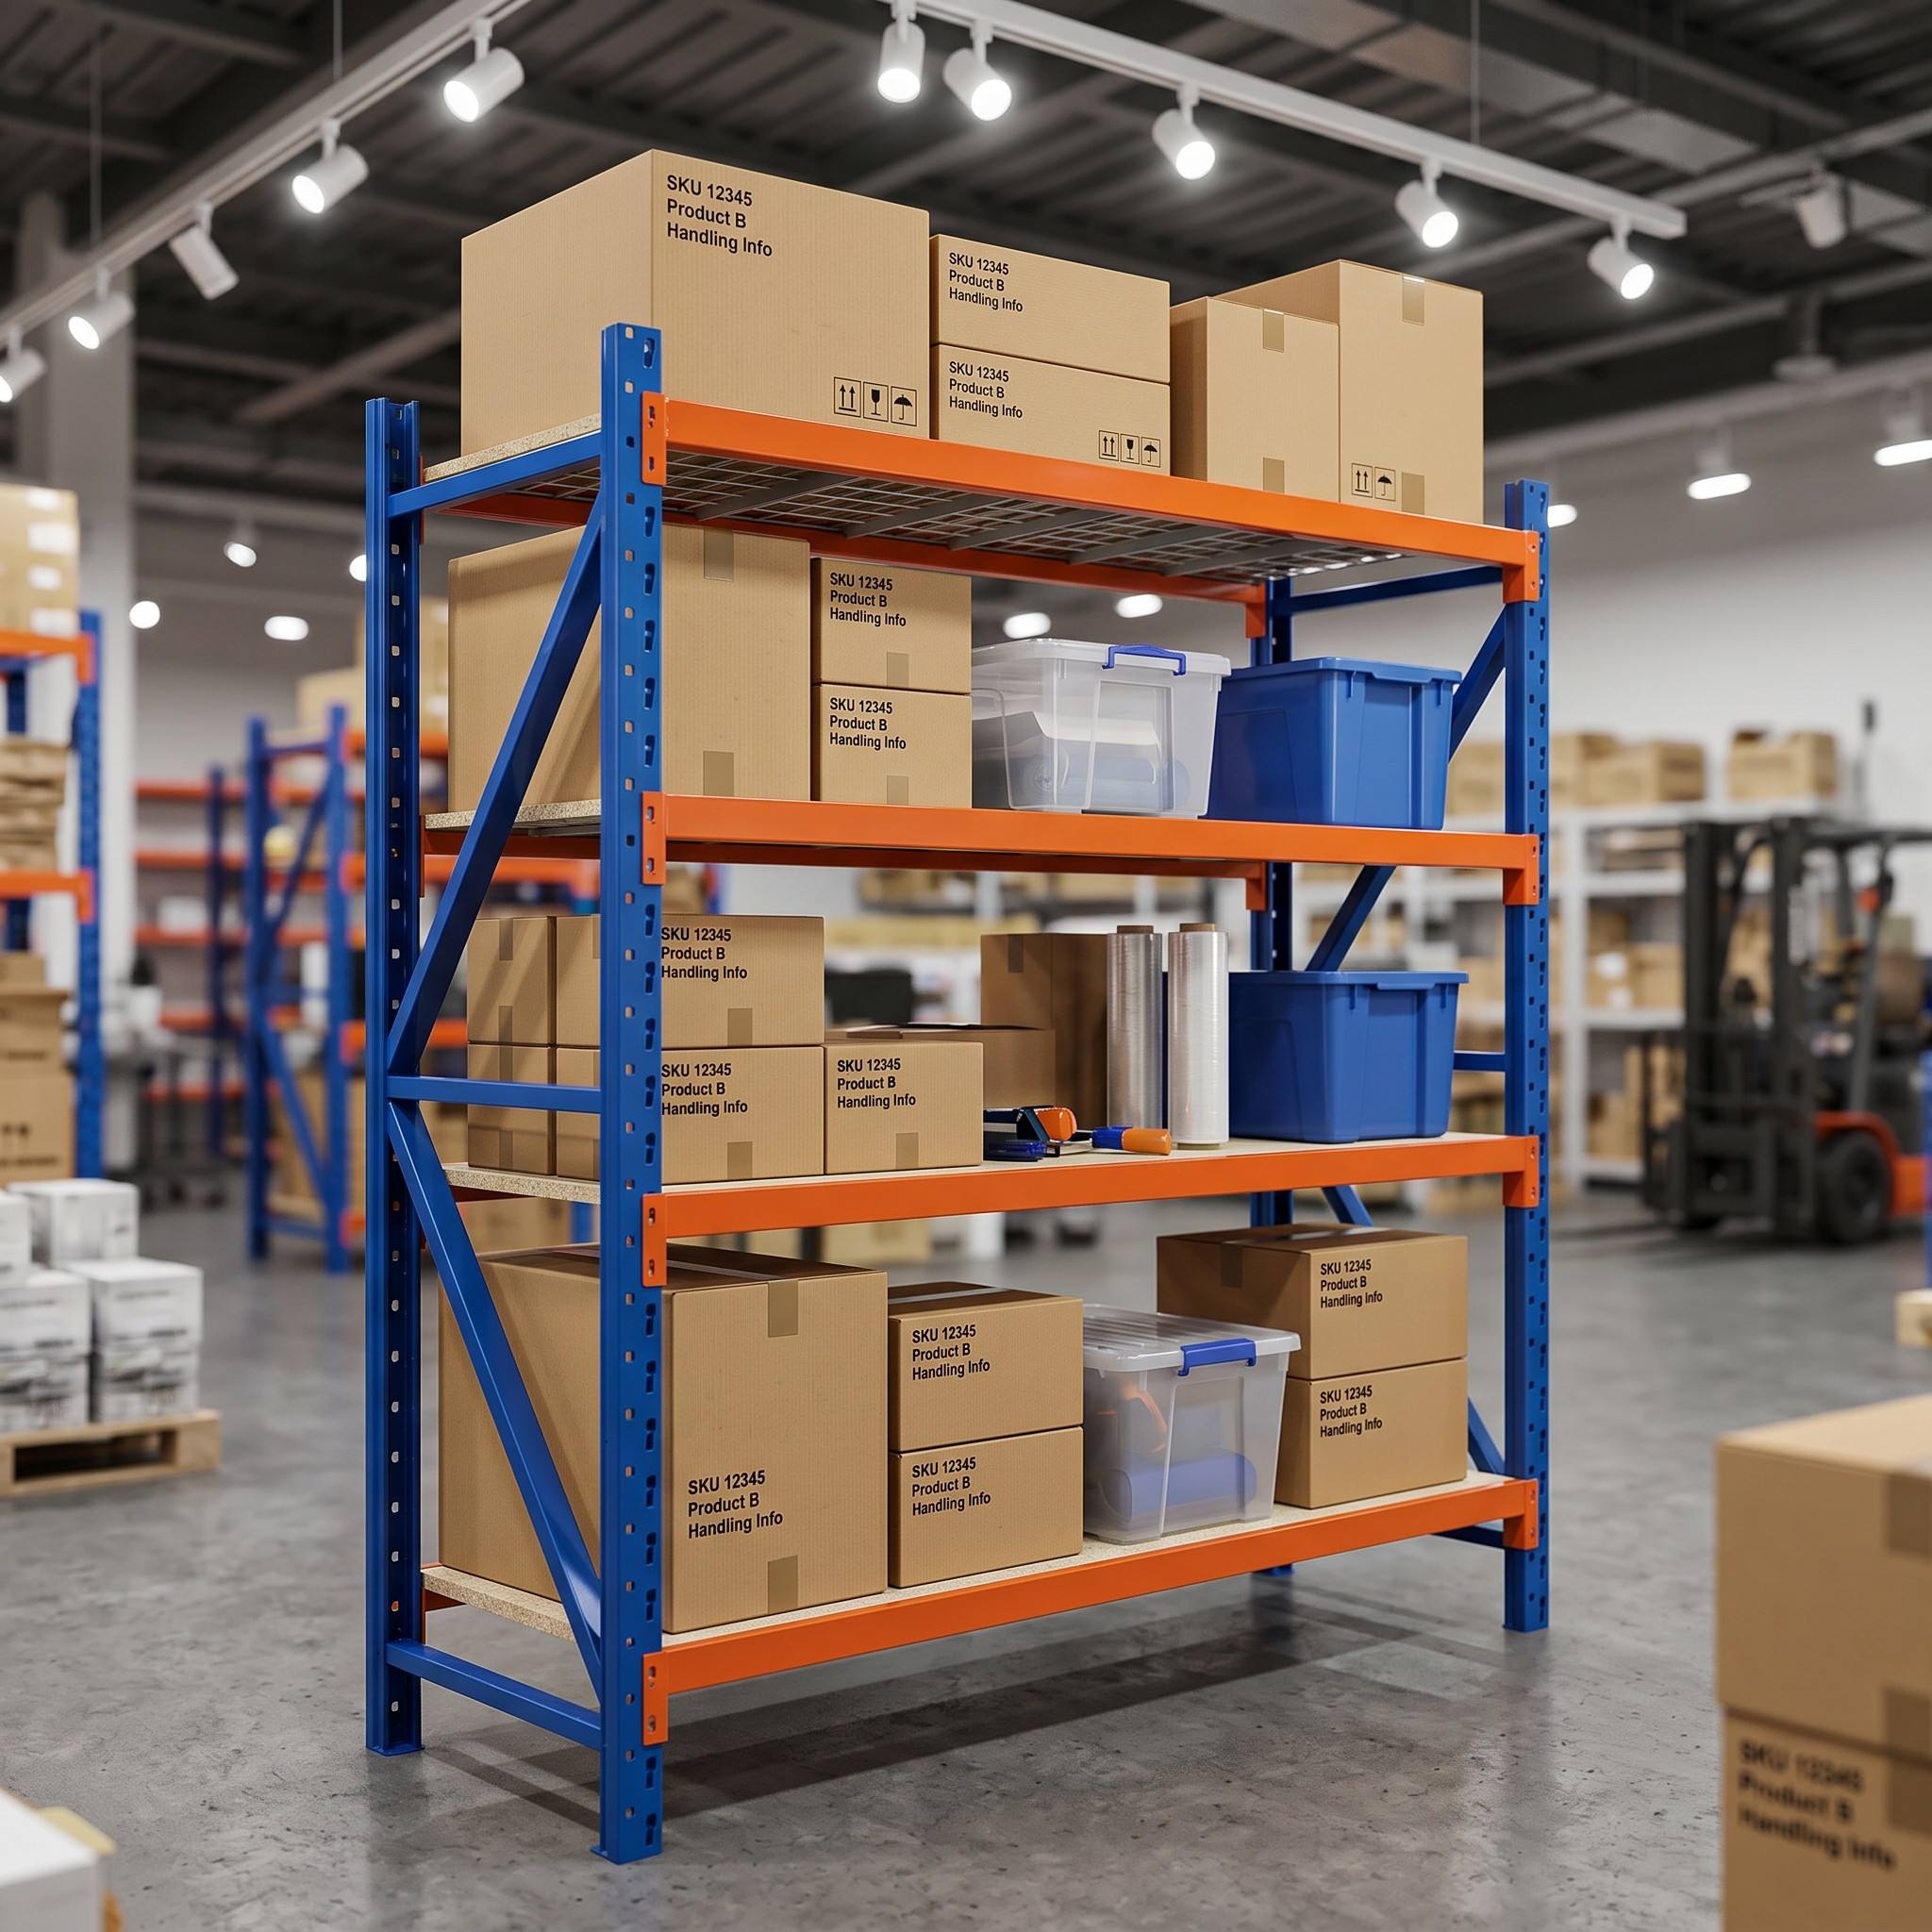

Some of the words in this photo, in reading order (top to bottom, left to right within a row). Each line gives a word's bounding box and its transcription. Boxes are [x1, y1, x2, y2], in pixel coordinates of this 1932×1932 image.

[666, 174, 702, 196] SKU
[707, 183, 753, 207] 12345
[667, 197, 731, 226] Product
[735, 211, 747, 229] B
[667, 221, 738, 255] Handling
[742, 236, 773, 258] Info
[948, 252, 974, 269] SKU
[976, 258, 1009, 275] 12345
[949, 268, 994, 291] Product
[996, 278, 1005, 291] B
[949, 286, 999, 311] Handling
[1002, 296, 1024, 312] Info
[948, 360, 974, 376] SKU
[976, 365, 1009, 383] 12345
[949, 377, 994, 398] Product
[996, 386, 1005, 399] B
[949, 394, 999, 418] Handling
[1002, 403, 1024, 419] Info
[829, 572, 856, 588] SKU
[858, 575, 893, 591] 12345
[830, 589, 876, 607] Product
[878, 594, 888, 608] B
[829, 607, 881, 629] Handling
[884, 612, 907, 627] Info
[829, 696, 856, 712] SKU
[858, 699, 893, 715] 12345
[829, 714, 875, 731] Product
[878, 718, 888, 732] B
[829, 731, 881, 752] Handling
[884, 735, 907, 750] Info
[661, 926, 691, 942] SKU
[693, 926, 733, 942] 12345
[661, 945, 713, 960] Product
[716, 946, 725, 960] B
[661, 965, 720, 983] Handling
[723, 965, 748, 979] Info
[661, 1063, 691, 1078] SKU
[693, 1062, 732, 1077] 12345
[837, 1058, 863, 1073] SKU
[866, 1058, 901, 1072] 12345
[661, 1082, 713, 1097] Product
[716, 1081, 726, 1095] B
[837, 1076, 885, 1091] Product
[887, 1075, 896, 1089] B
[661, 1100, 720, 1118] Handling
[724, 1099, 748, 1114] Info
[837, 1094, 891, 1110] Handling
[893, 1092, 917, 1107] Info
[1320, 1261, 1341, 1276] SKU
[1343, 1258, 1372, 1274] 12345
[1320, 1276, 1358, 1292] Product
[1359, 1274, 1368, 1289] B
[1320, 1293, 1363, 1309] Handling
[1364, 1290, 1383, 1304] Info
[911, 1327, 939, 1344] SKU
[941, 1324, 976, 1341] 12345
[912, 1344, 959, 1362] Product
[961, 1342, 971, 1357] B
[912, 1362, 965, 1381] Handling
[968, 1357, 991, 1374] Info
[1320, 1389, 1341, 1405] SKU
[1343, 1384, 1373, 1401] 12345
[1320, 1404, 1357, 1422] Product
[1359, 1402, 1367, 1415] B
[1320, 1422, 1362, 1438] Handling
[1364, 1416, 1383, 1431] Info
[911, 1461, 939, 1479] SKU
[941, 1456, 976, 1474] 12345
[688, 1475, 720, 1495] SKU
[724, 1469, 766, 1491] 12345
[911, 1477, 959, 1498] Product
[961, 1475, 971, 1490] B
[688, 1494, 746, 1518] Product
[749, 1491, 759, 1508] B
[912, 1496, 965, 1517] Handling
[968, 1491, 991, 1507] Info
[688, 1516, 753, 1540] Handling
[756, 1510, 784, 1528] Info
